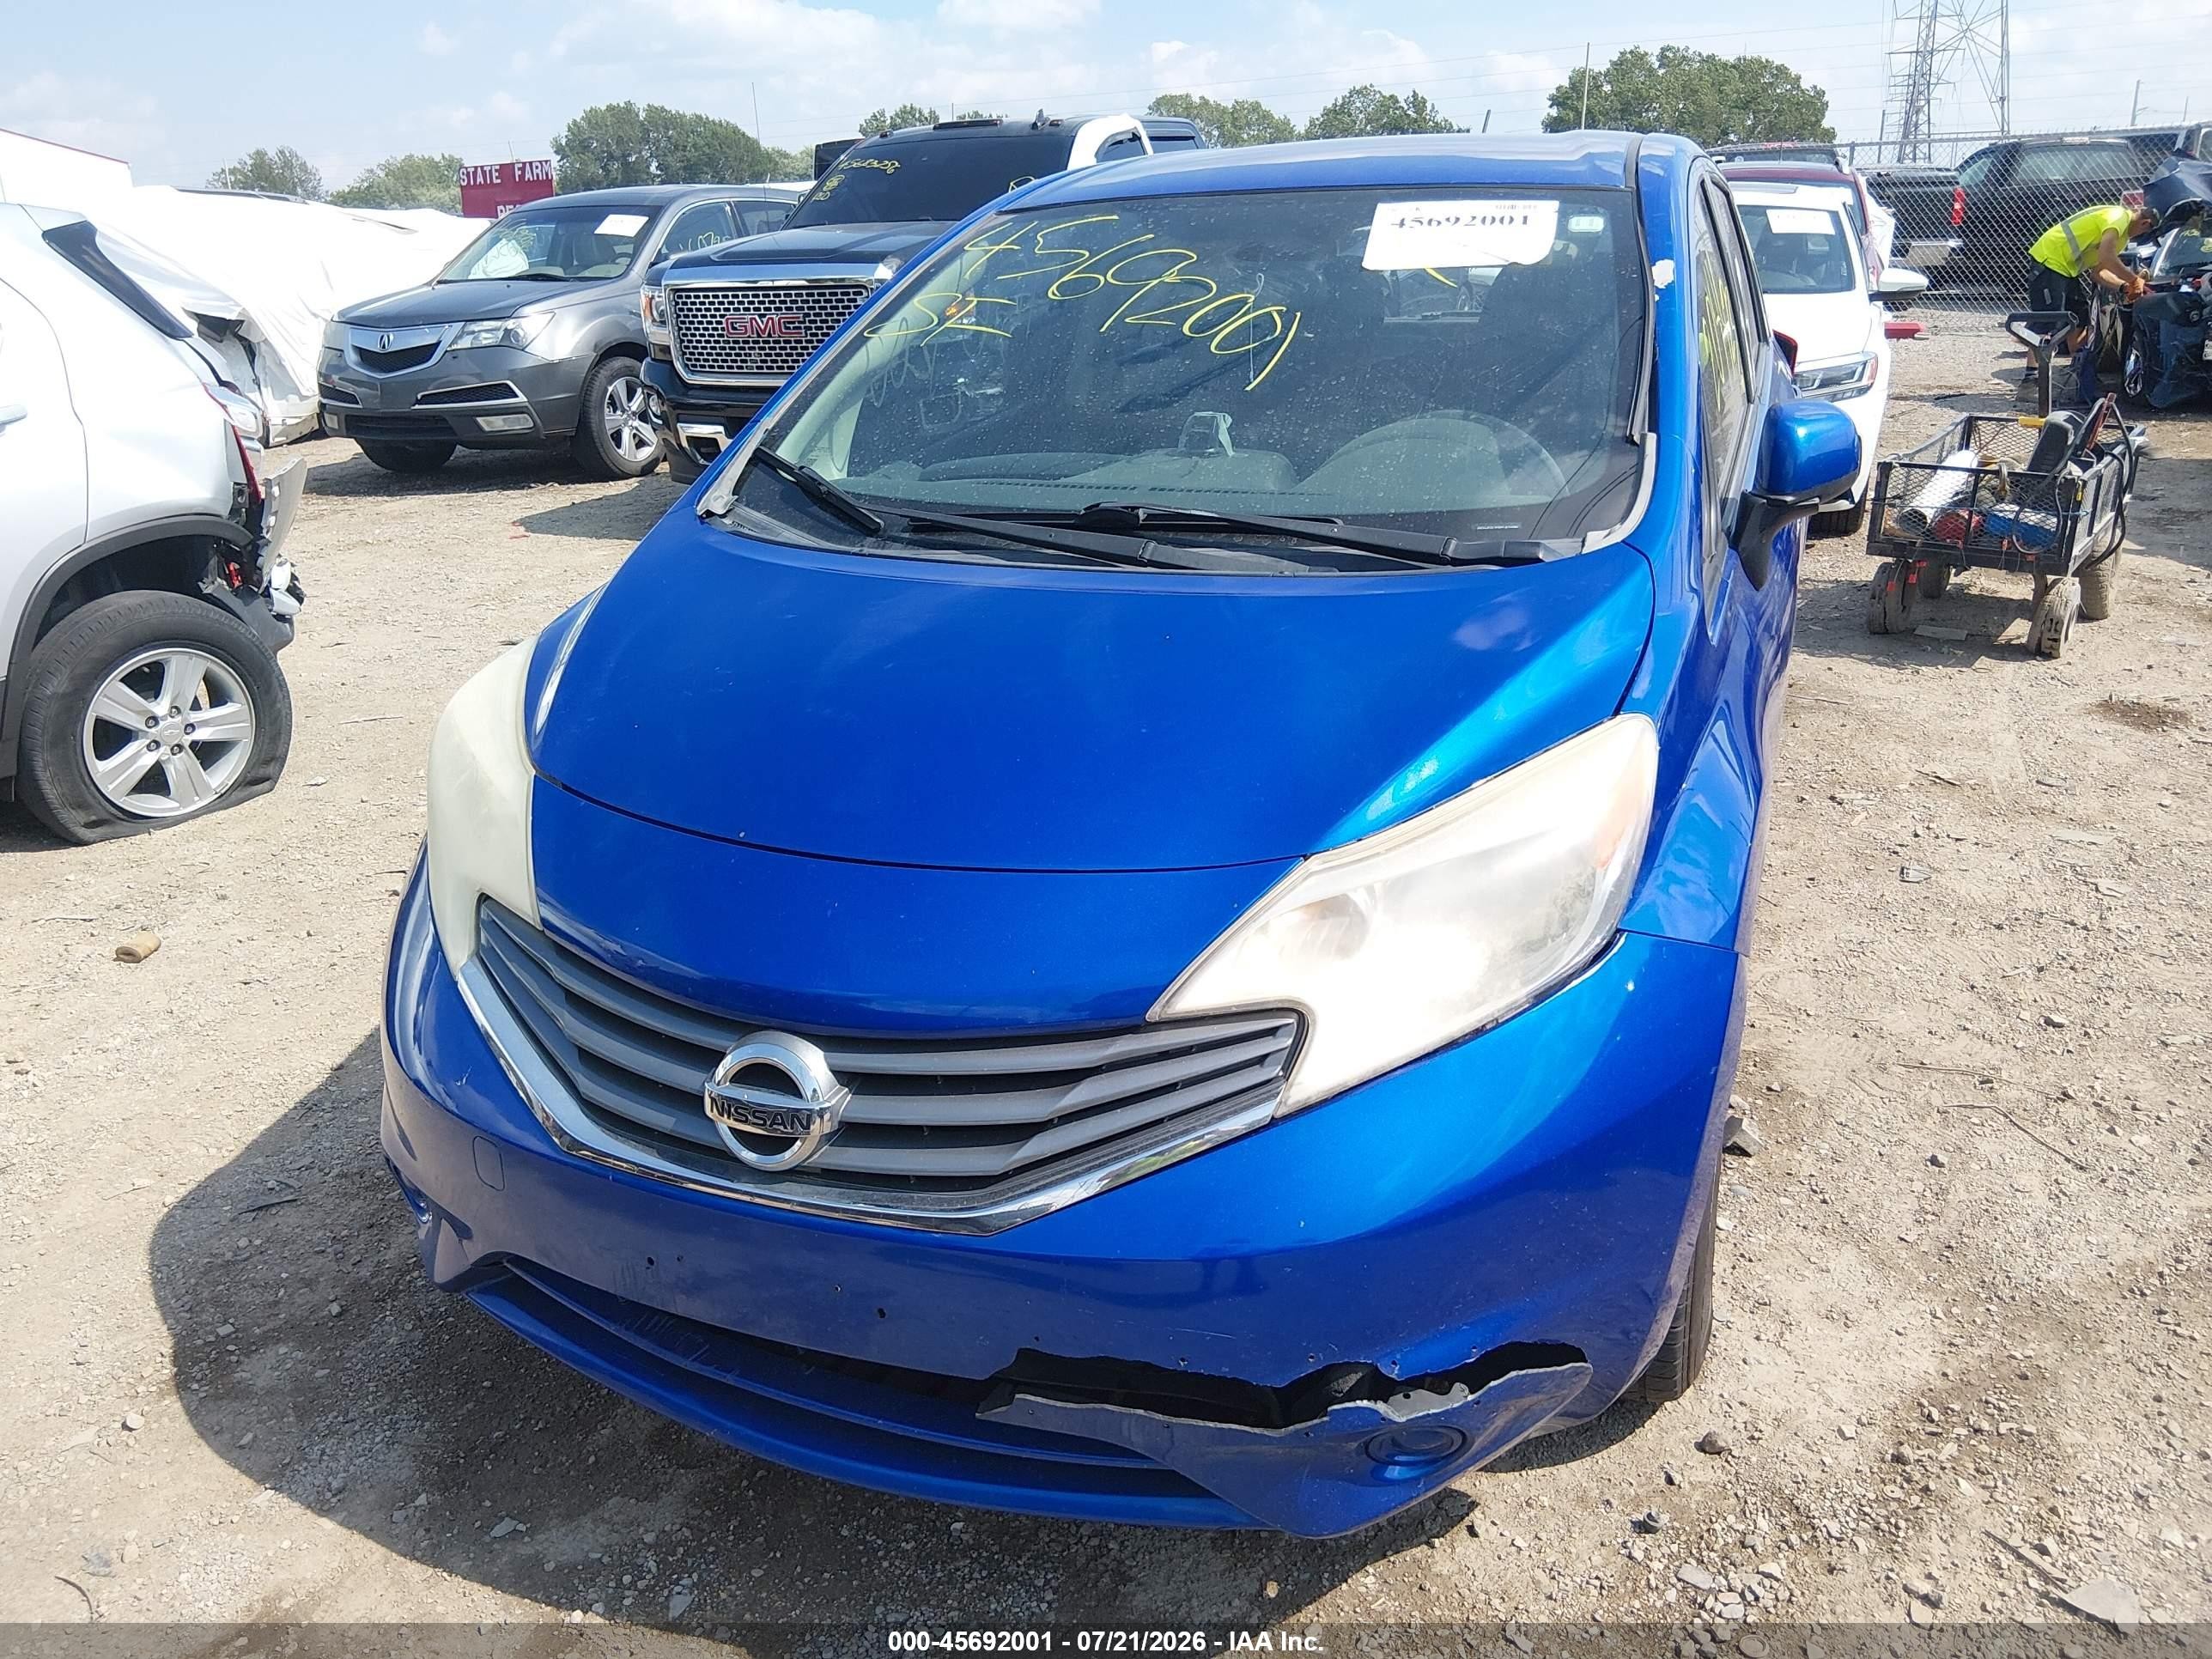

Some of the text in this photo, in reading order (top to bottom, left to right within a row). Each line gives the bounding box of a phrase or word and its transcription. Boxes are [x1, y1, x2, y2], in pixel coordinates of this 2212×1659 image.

[459, 161, 552, 186] STATE FARM
[963, 215, 1301, 392] 45692001
[725, 314, 805, 337] GMC
[708, 1094, 811, 1131] NISSAN
